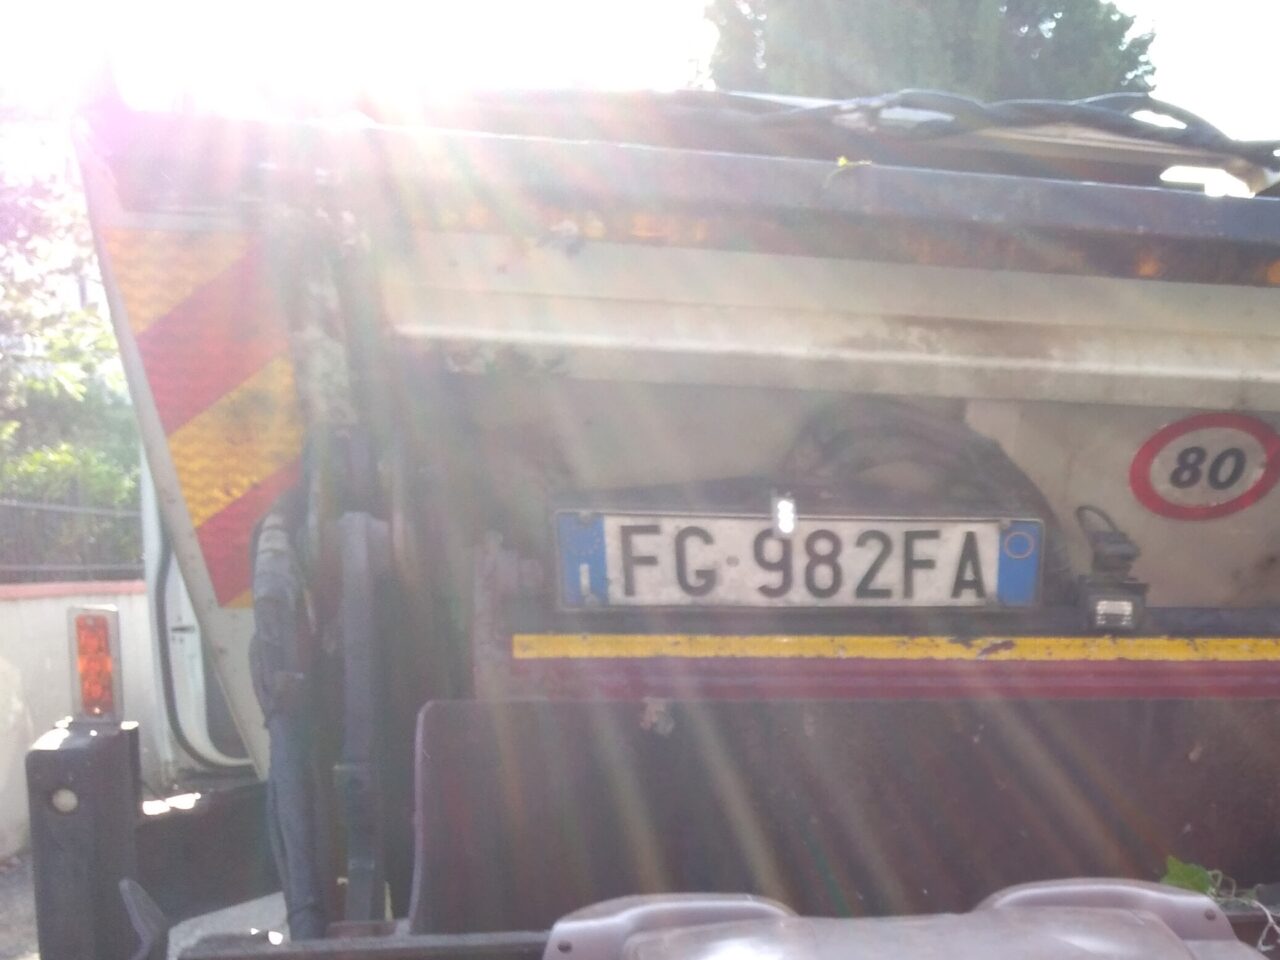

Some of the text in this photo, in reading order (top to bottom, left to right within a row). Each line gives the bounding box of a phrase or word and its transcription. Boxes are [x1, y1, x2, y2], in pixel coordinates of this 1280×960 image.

[1169, 445, 1247, 490] 80
[620, 525, 987, 600] FG 982FA
